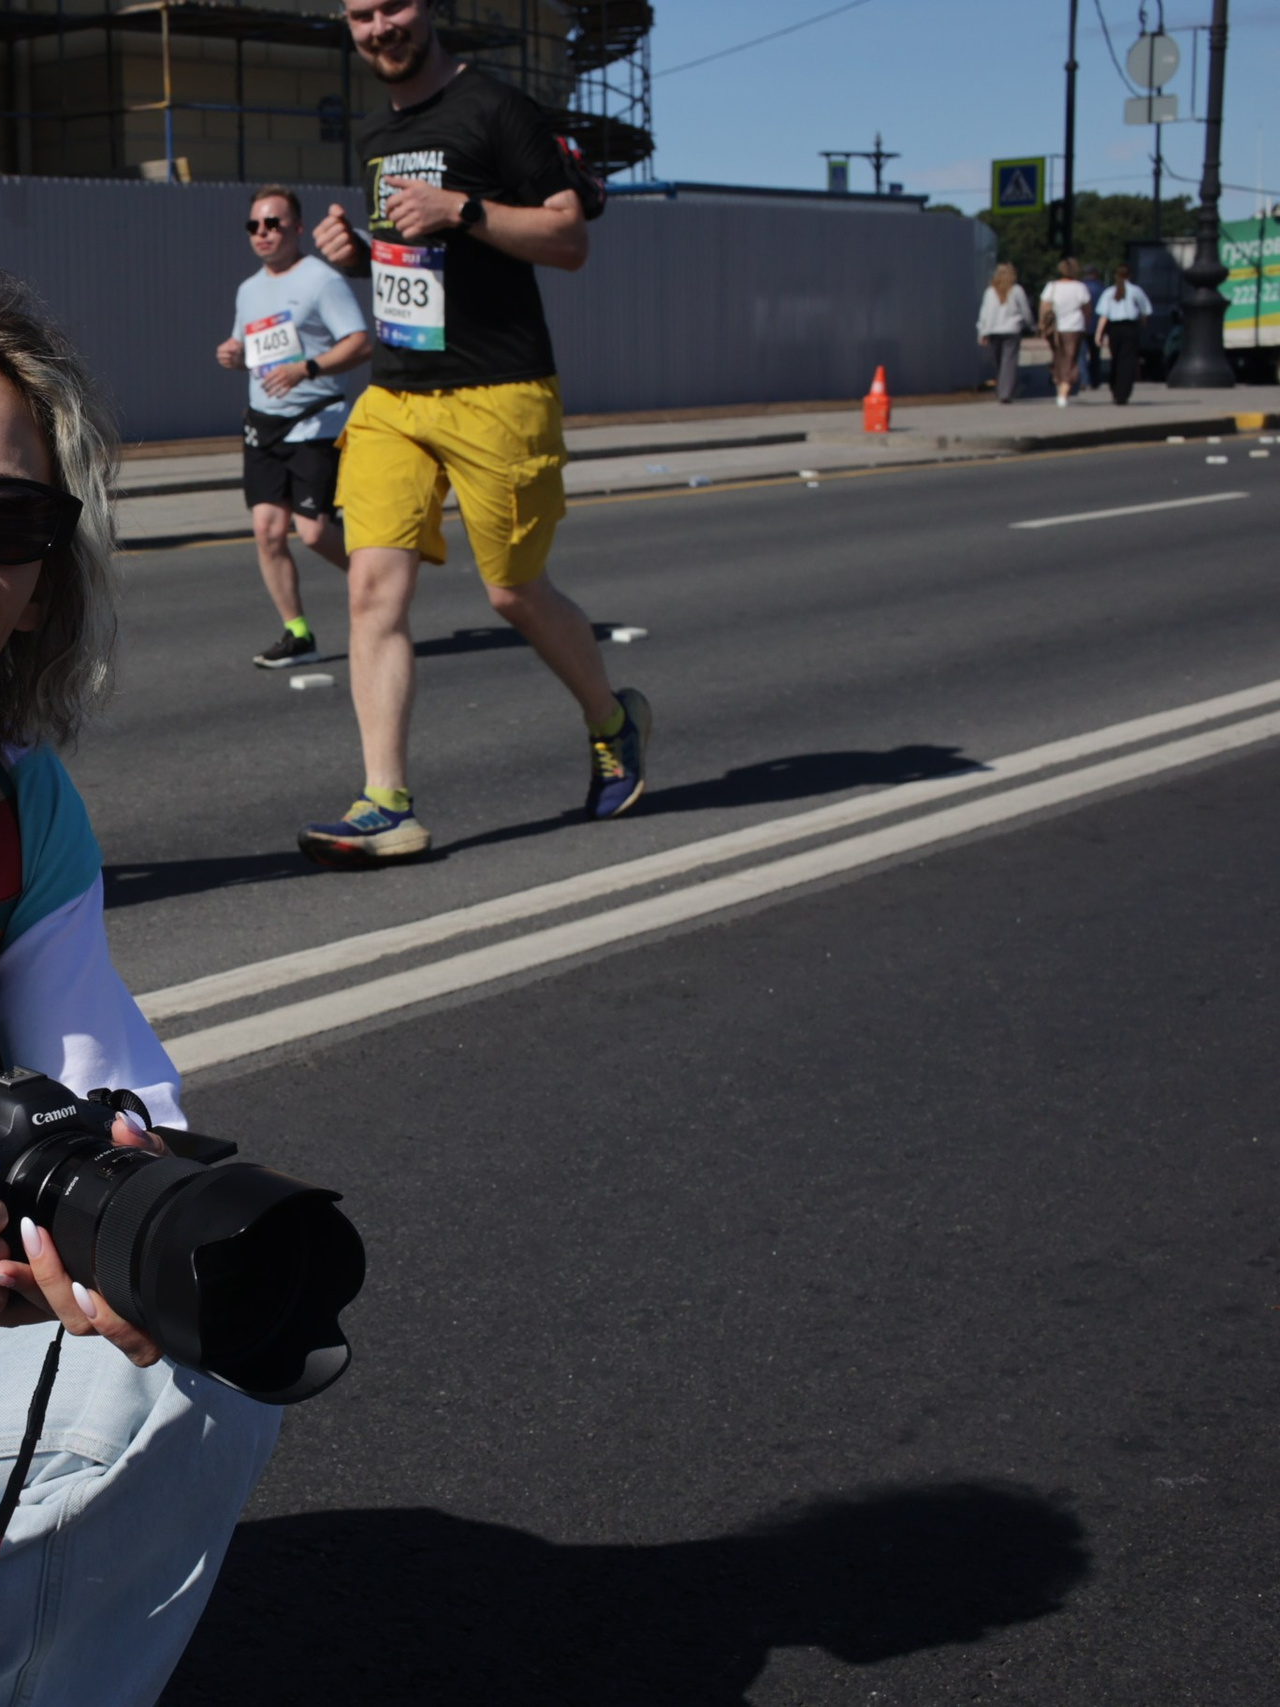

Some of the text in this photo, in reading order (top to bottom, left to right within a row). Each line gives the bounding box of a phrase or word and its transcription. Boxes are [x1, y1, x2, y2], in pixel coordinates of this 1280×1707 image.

[381, 150, 447, 174] NATIONAL
[376, 272, 428, 307] 4783
[254, 329, 290, 354] 1403
[32, 1104, 77, 1126] Canon
